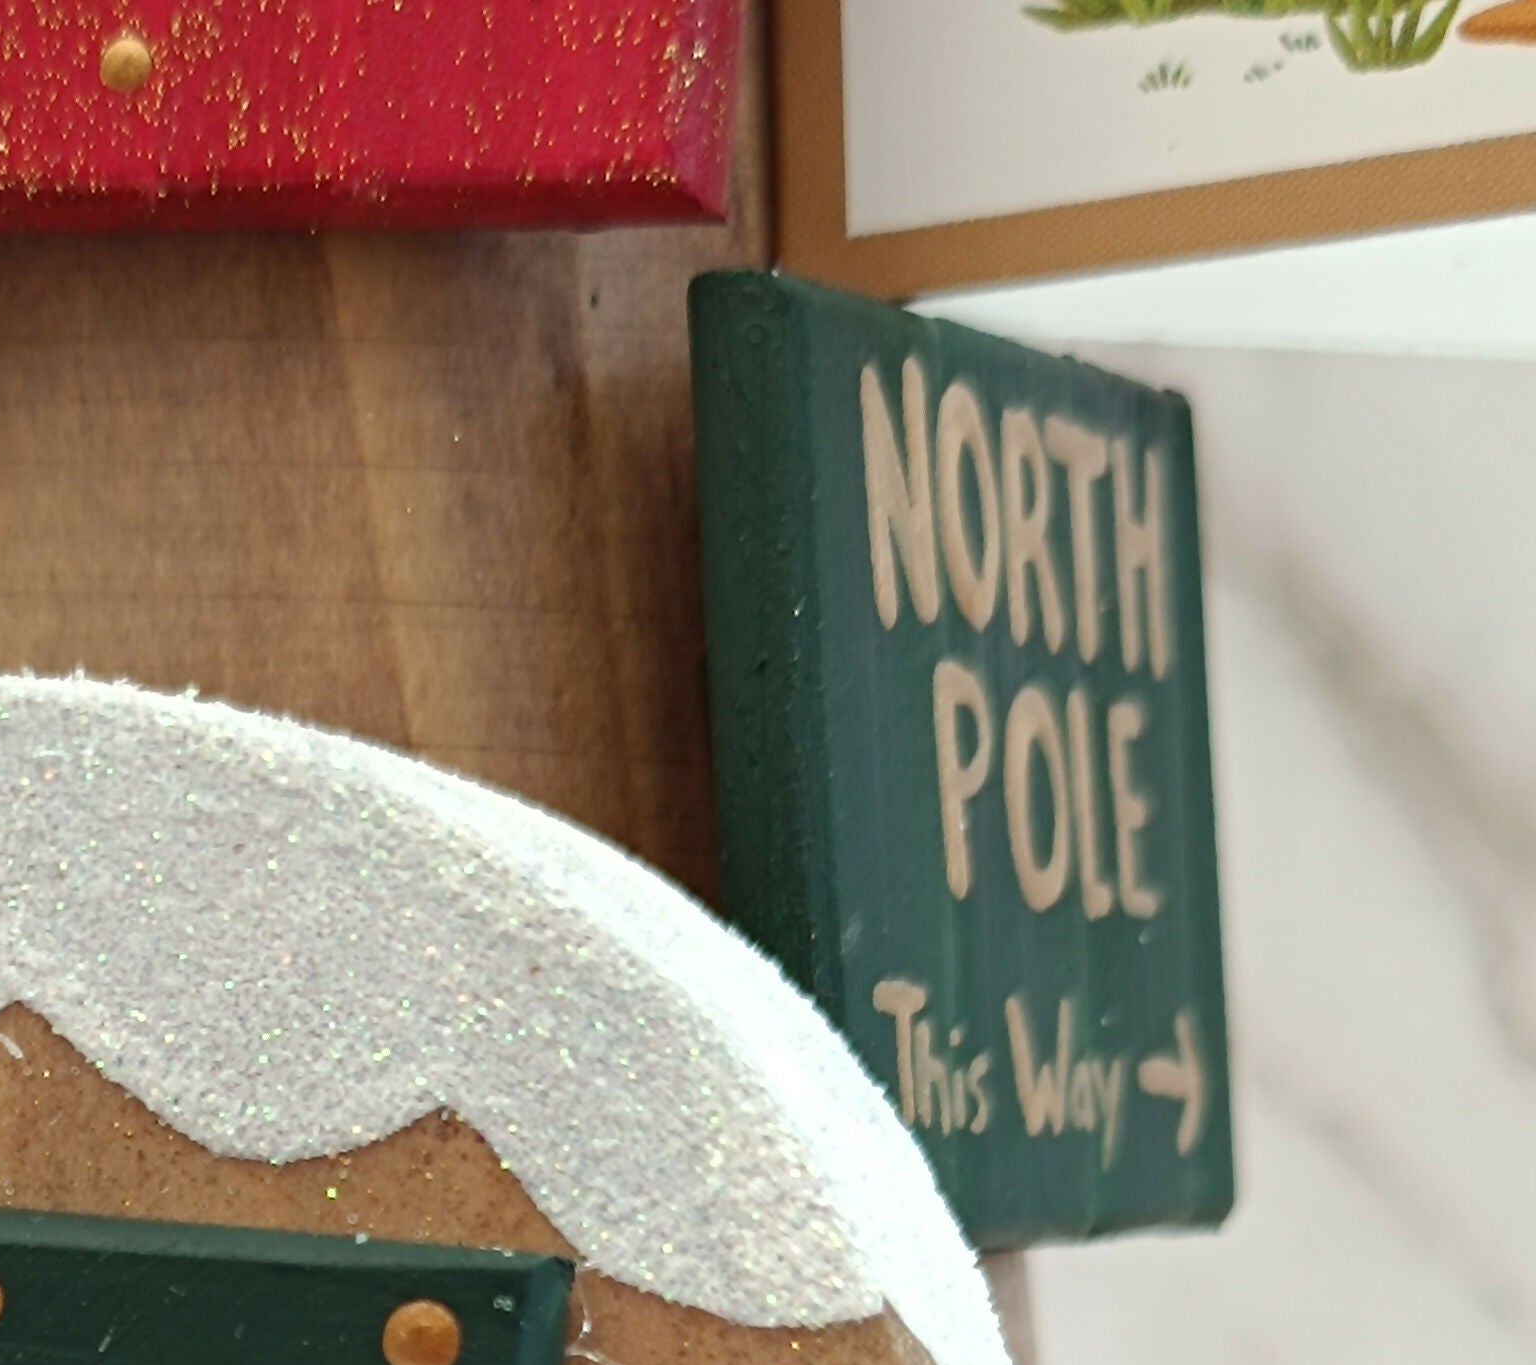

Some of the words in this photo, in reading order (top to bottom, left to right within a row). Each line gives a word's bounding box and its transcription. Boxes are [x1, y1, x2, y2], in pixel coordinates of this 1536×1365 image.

[860, 353, 1172, 681] NORTH
[932, 659, 1162, 922] POLE
[872, 979, 990, 1138] This
[1005, 994, 1131, 1174] Way
